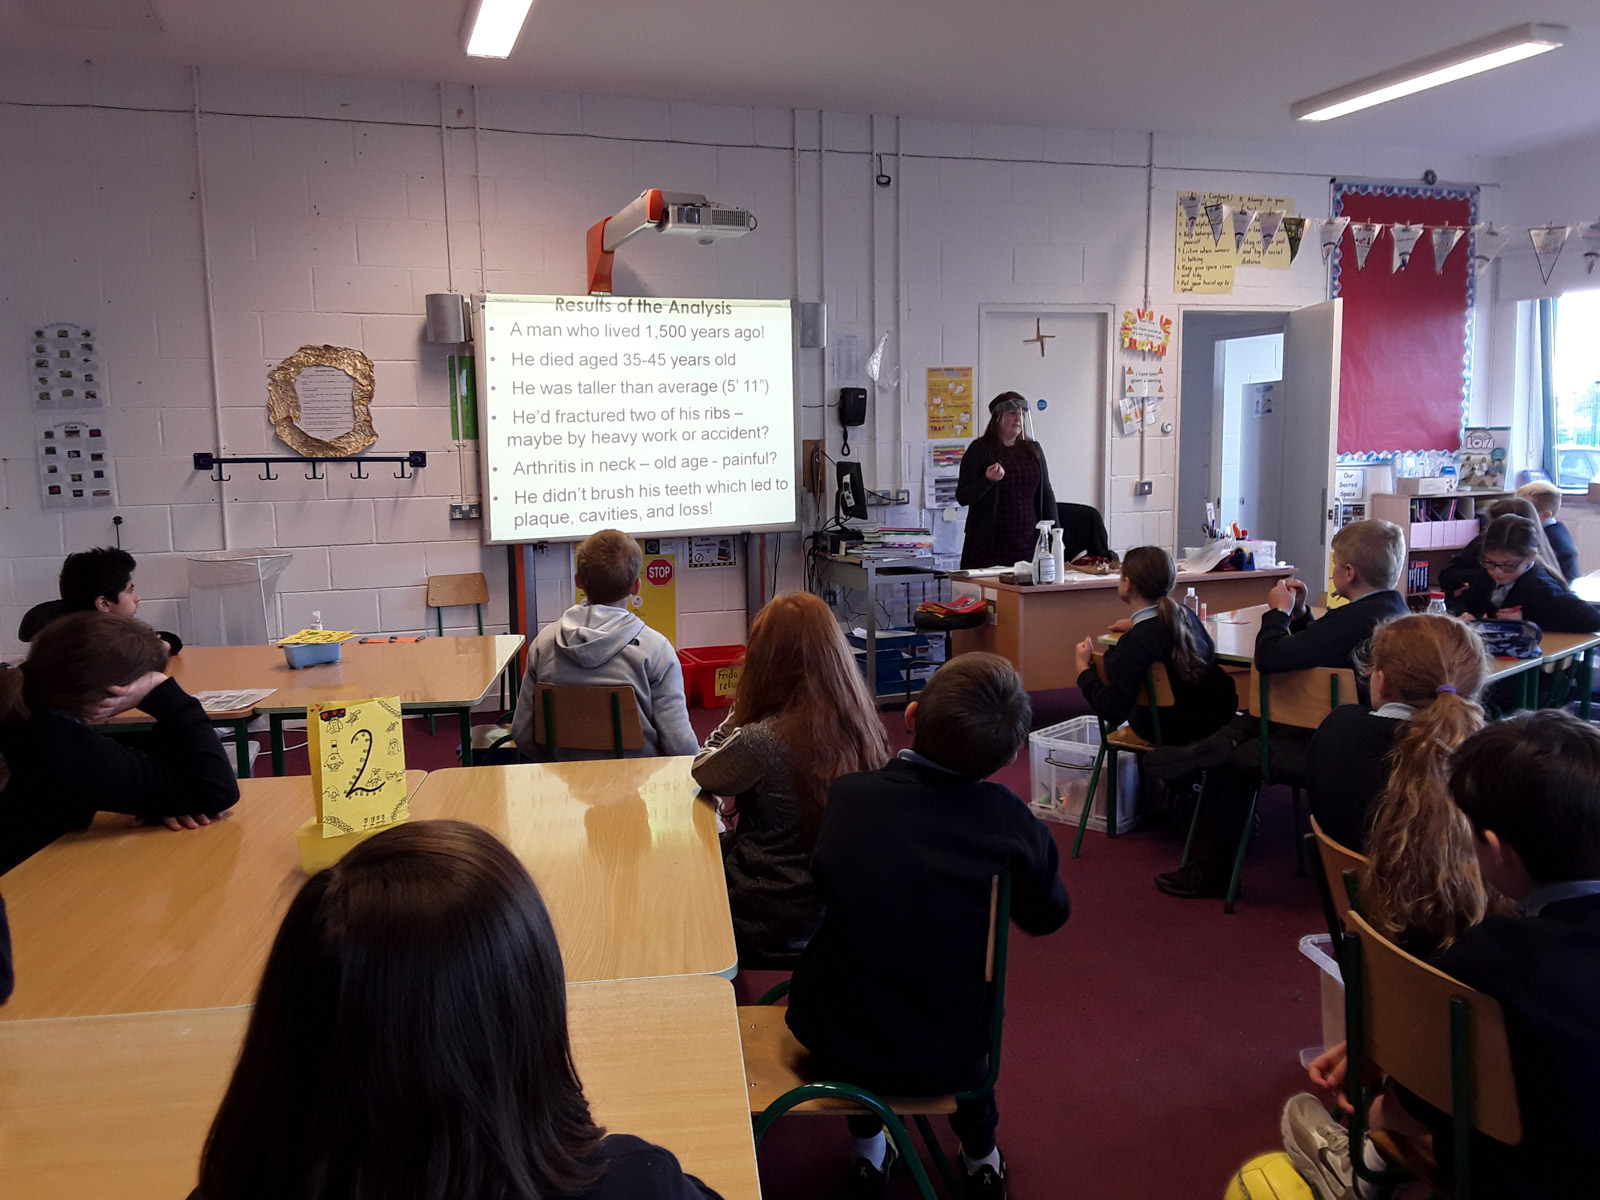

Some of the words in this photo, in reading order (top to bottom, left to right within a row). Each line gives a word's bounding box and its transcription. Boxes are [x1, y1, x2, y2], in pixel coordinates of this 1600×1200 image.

[555, 296, 611, 312] Results
[617, 299, 635, 313] of
[637, 299, 662, 313] the
[668, 300, 732, 317] Analysis
[510, 322, 522, 336] A
[527, 326, 561, 336] man
[567, 324, 599, 336] who
[605, 324, 639, 337] lived
[646, 325, 686, 339] 1,500
[691, 328, 729, 341] years
[735, 326, 764, 341] ago!
[512, 352, 534, 366] He
[540, 353, 573, 366] died
[579, 353, 617, 369] aged
[624, 353, 666, 366] 35-45
[671, 356, 710, 369] years
[715, 353, 735, 365] old
[513, 381, 535, 395] He
[540, 384, 572, 394] was
[578, 381, 616, 394] taller
[621, 381, 653, 393] than
[658, 383, 717, 396] average
[514, 410, 550, 424] He'd
[555, 408, 625, 423] fractured
[630, 409, 655, 421] two
[661, 408, 675, 420] of
[680, 407, 700, 420] his
[705, 407, 730, 419] ribs
[508, 432, 562, 449] maybe
[568, 431, 585, 447] by
[592, 431, 637, 446] heavy
[642, 429, 677, 442] work
[682, 431, 696, 441] or
[702, 426, 769, 440] accident?
[513, 460, 576, 475] Arthritis
[581, 459, 593, 472] in
[600, 457, 636, 471] neck
[655, 456, 676, 469] old
[681, 457, 708, 471] age
[723, 452, 777, 469] painful?
[515, 490, 537, 504] He
[543, 488, 586, 502] didn't
[591, 485, 633, 500] brush
[640, 484, 660, 497] his
[665, 482, 701, 496] teeth
[706, 480, 746, 493] which
[751, 478, 771, 491] led
[776, 478, 788, 490] to
[515, 512, 573, 530] plaque,
[579, 507, 641, 522] cavities,
[647, 504, 674, 518] and
[680, 502, 712, 516] loss!
[649, 566, 671, 579] STOP
[718, 668, 738, 680] Frida
[345, 729, 386, 798] 2
